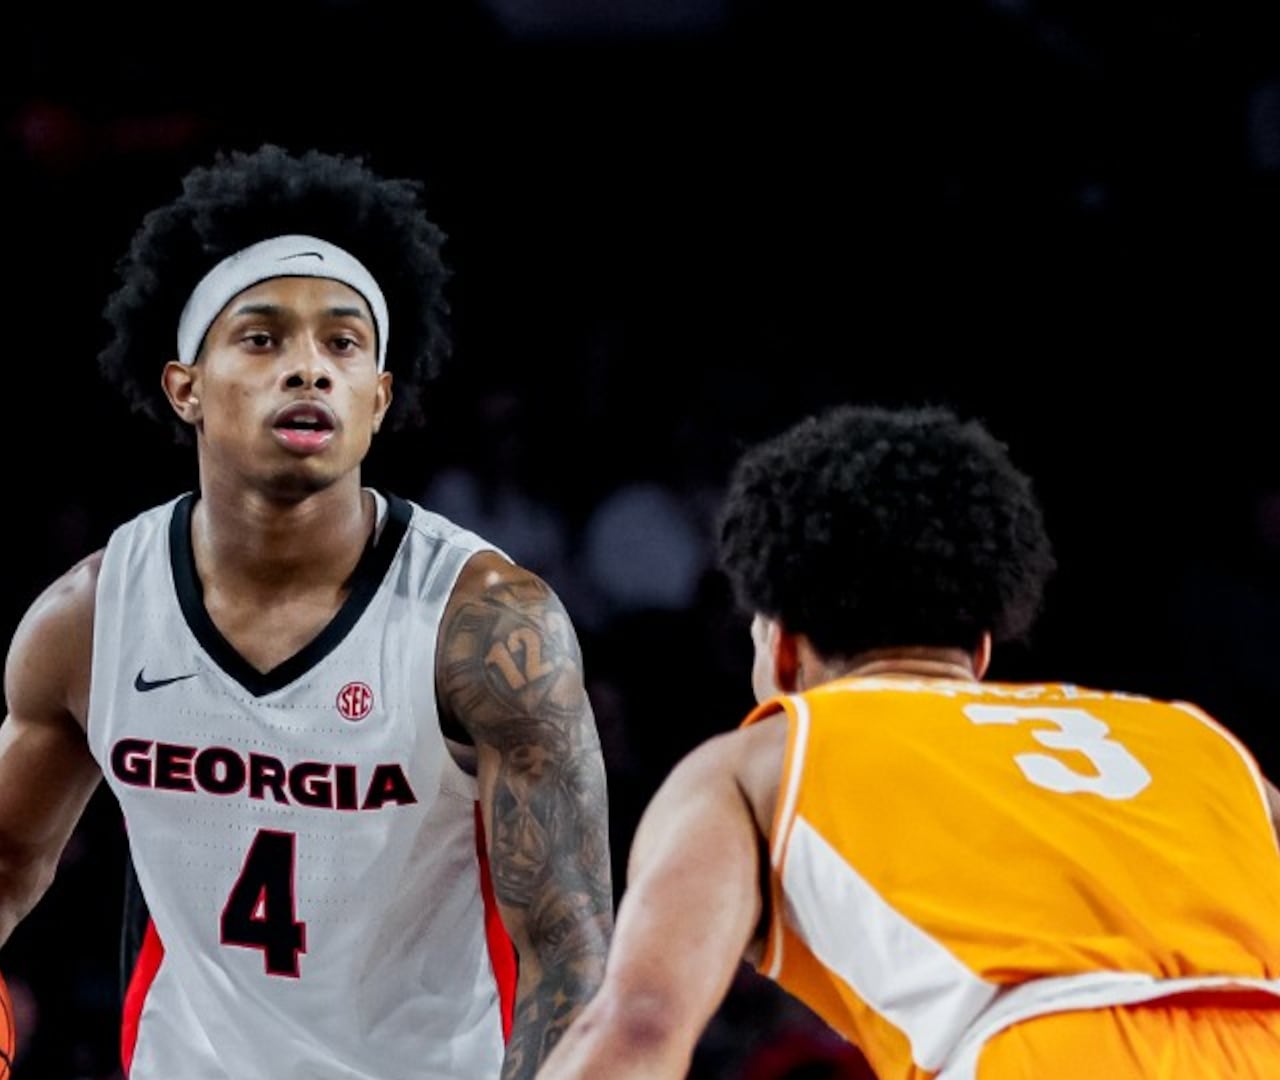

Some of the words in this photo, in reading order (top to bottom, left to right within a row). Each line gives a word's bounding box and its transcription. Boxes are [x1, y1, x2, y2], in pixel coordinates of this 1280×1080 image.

[341, 685, 371, 717] SEC
[110, 738, 418, 810] GEORGIA
[962, 704, 1152, 800] 3
[220, 828, 307, 979] 4
